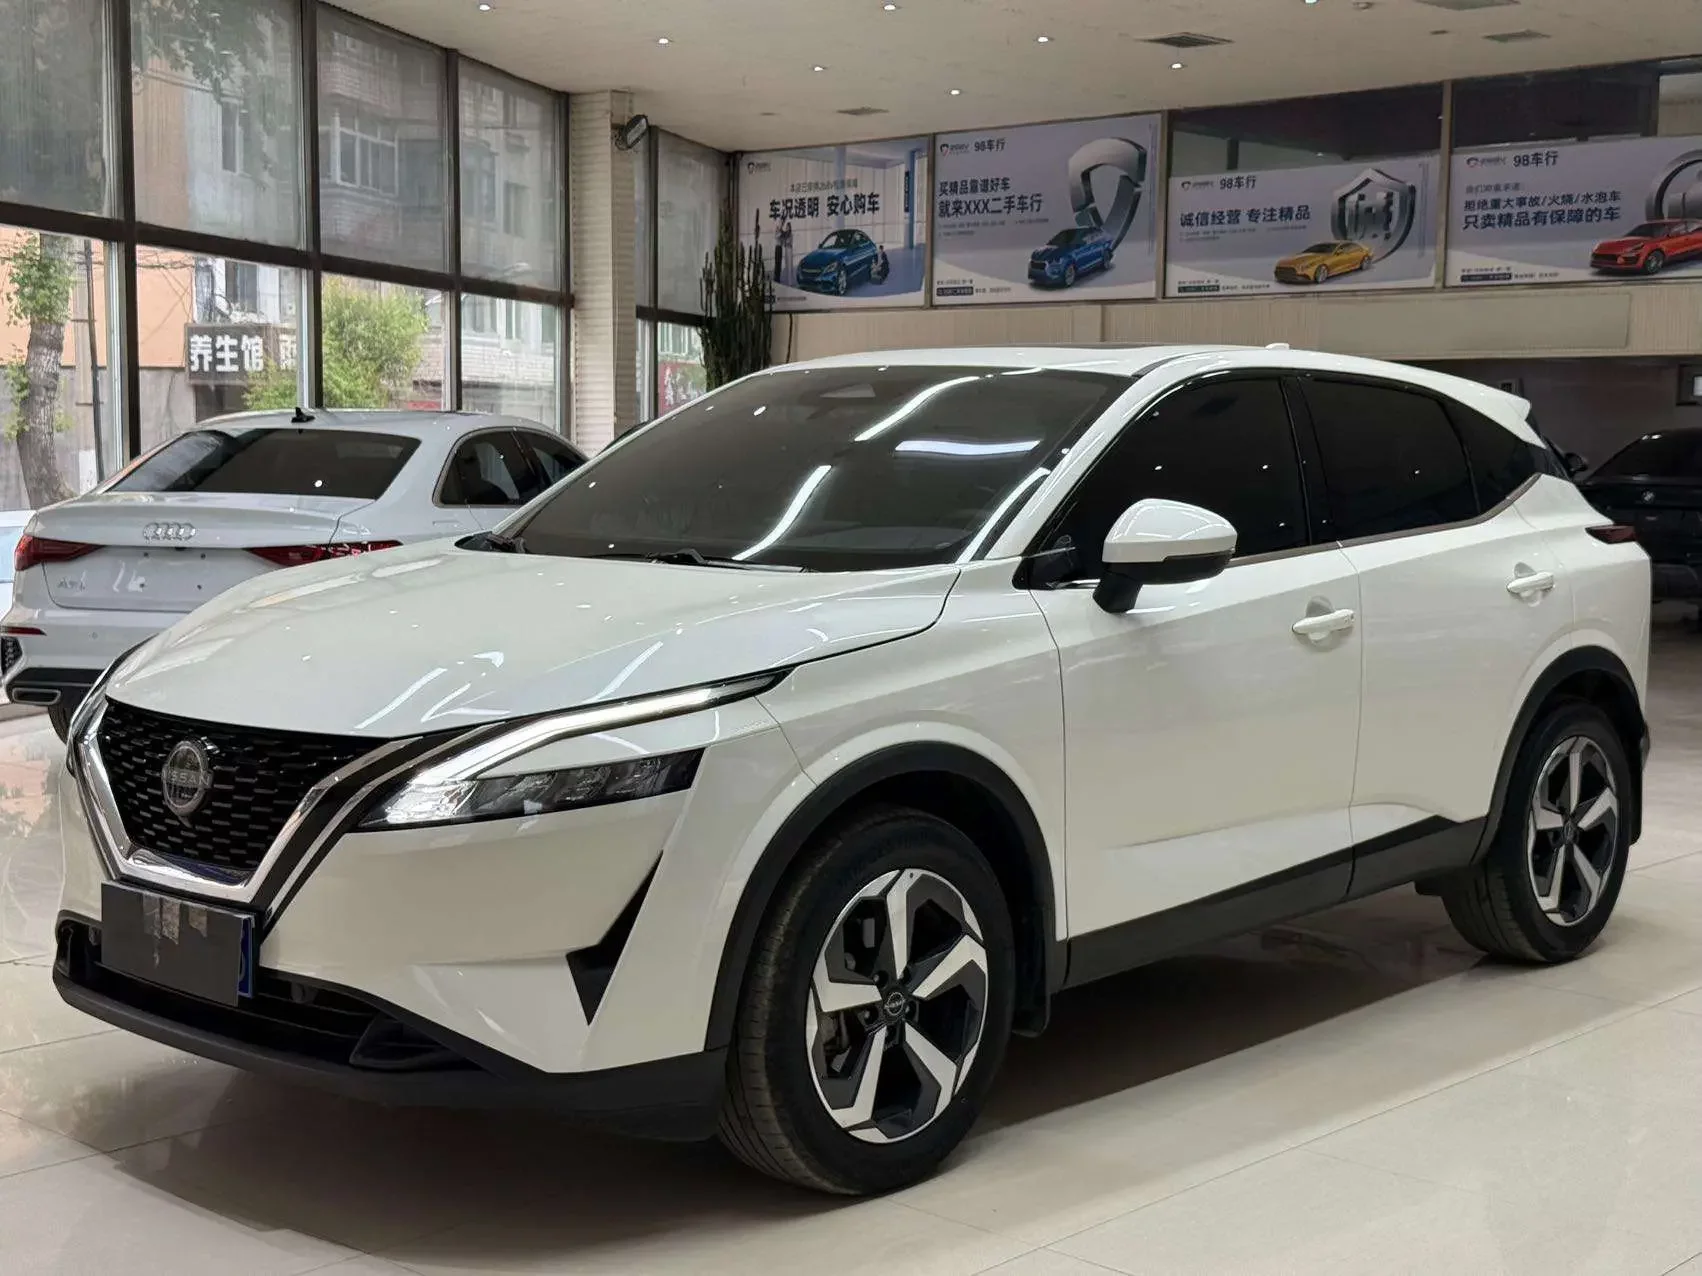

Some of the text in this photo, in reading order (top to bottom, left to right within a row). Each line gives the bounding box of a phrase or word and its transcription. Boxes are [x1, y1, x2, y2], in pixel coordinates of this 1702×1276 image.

[1513, 151, 1559, 167] 98车行
[939, 177, 1011, 196] 买精品靠谱好车
[1220, 175, 1257, 189] 98车行
[769, 192, 880, 219] 车况透明 安心购车
[938, 193, 1043, 218] 就来XXX二手车行
[1180, 205, 1311, 227] 诚信经营 专注精品
[1462, 206, 1621, 230] 只卖精品有保障的车
[190, 334, 264, 372] 养生馆
